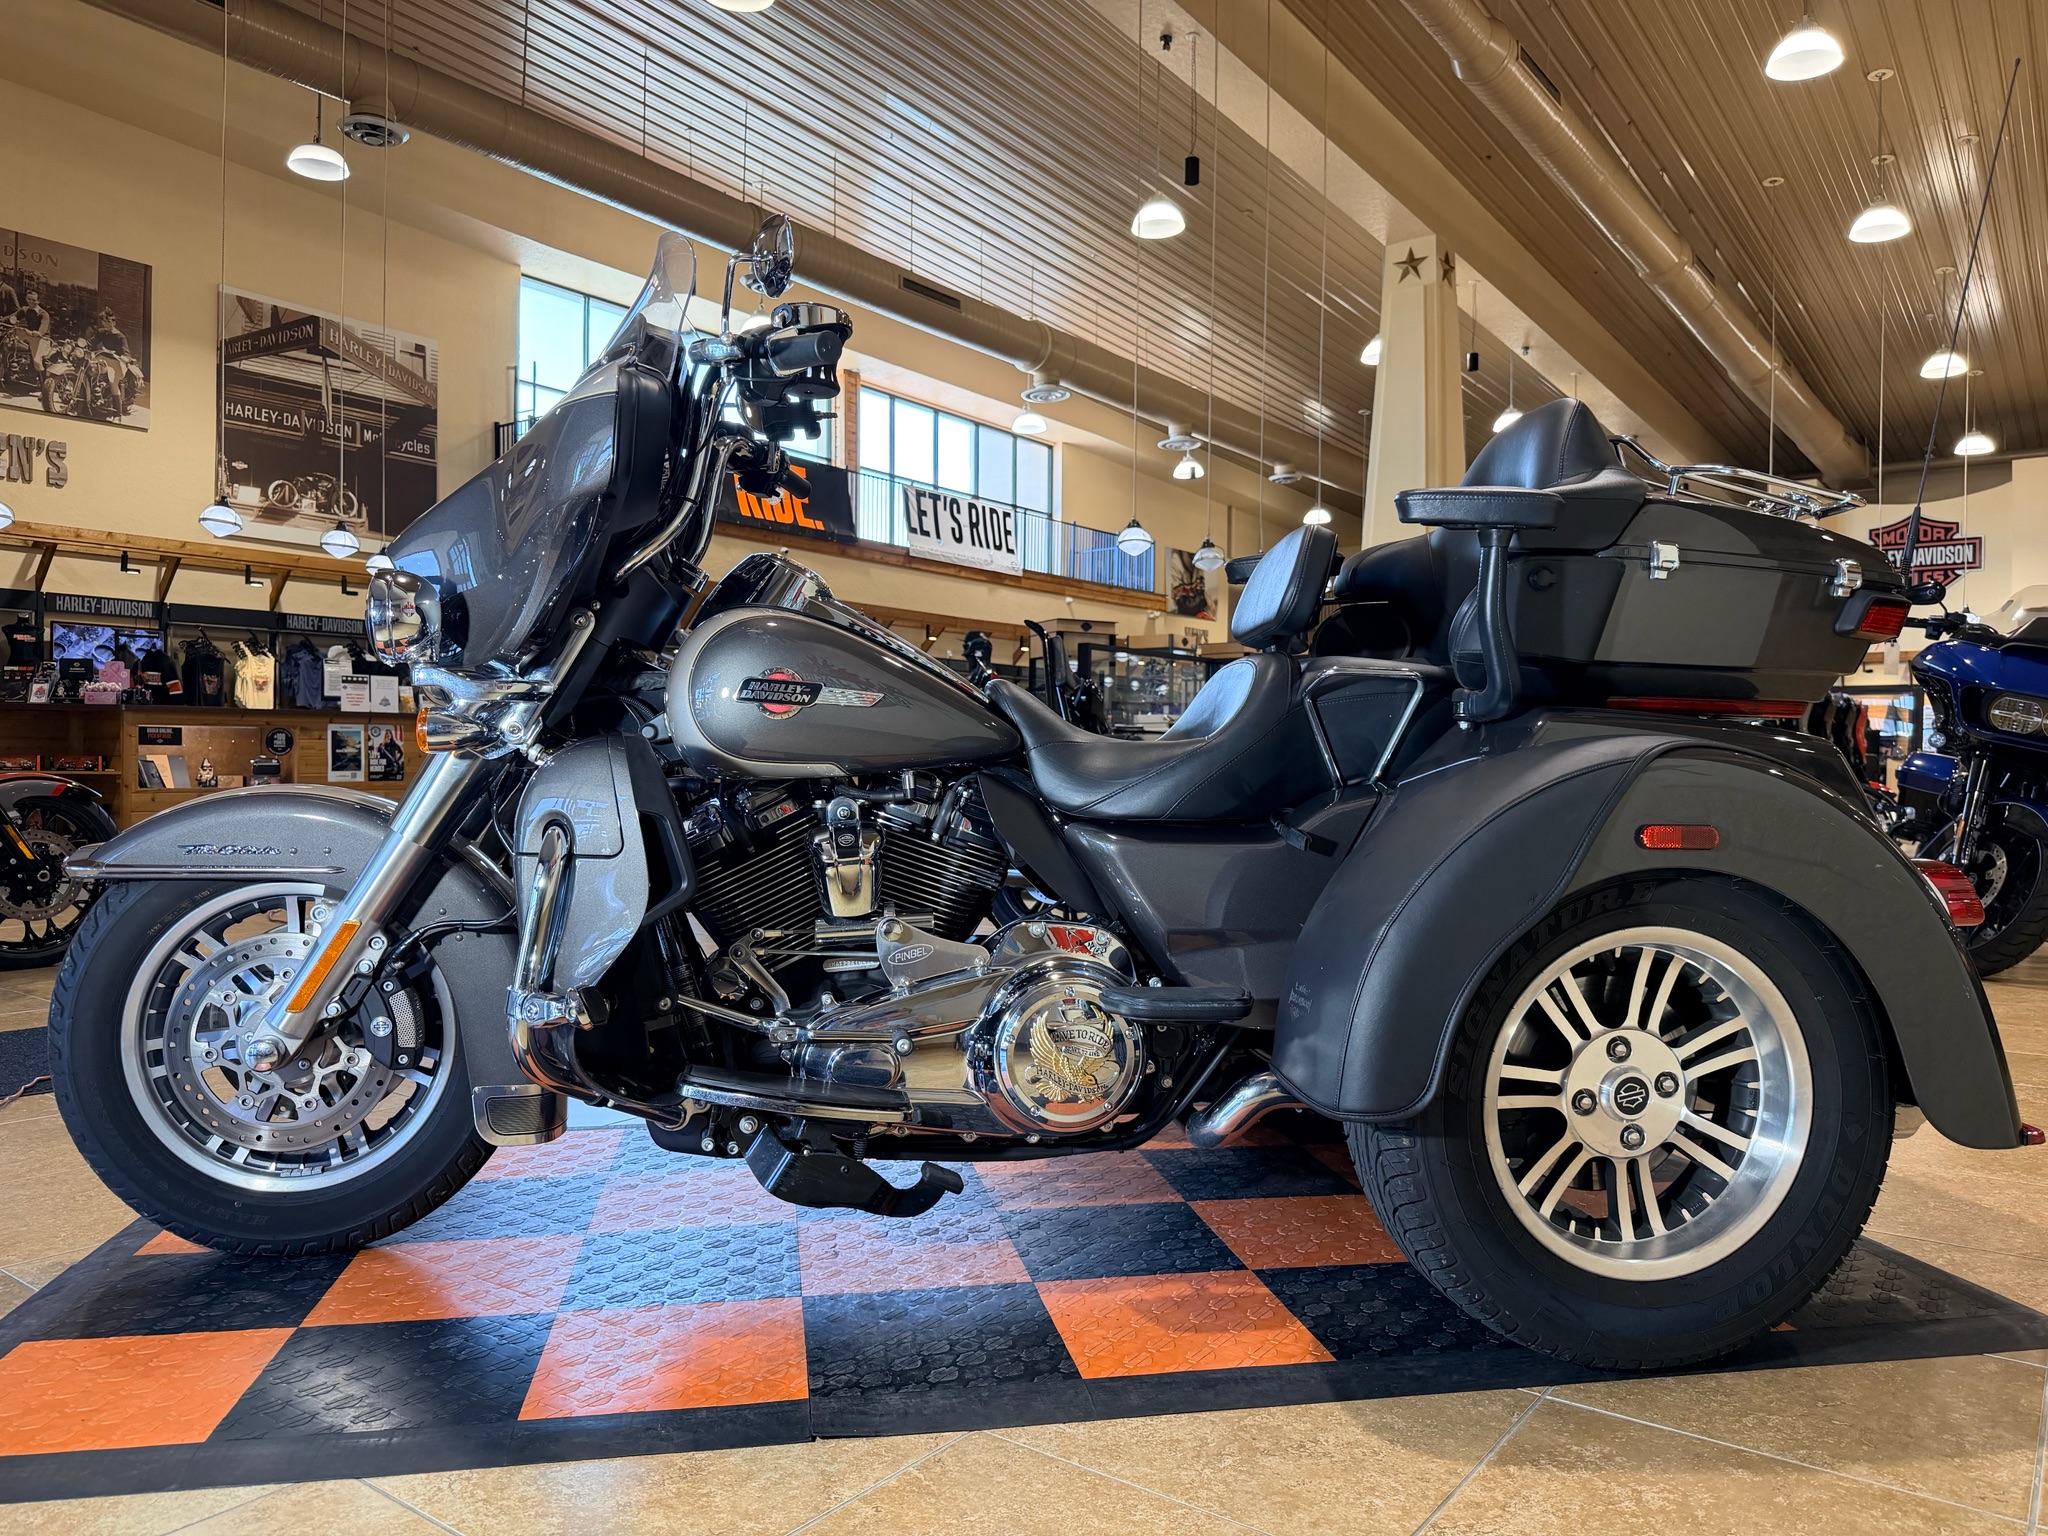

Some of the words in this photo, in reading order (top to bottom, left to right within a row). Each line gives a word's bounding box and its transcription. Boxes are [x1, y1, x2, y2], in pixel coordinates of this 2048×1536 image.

[0, 432, 68, 489] N'S
[904, 489, 963, 544] LET'S
[967, 500, 1016, 555] RIDE
[1882, 525, 1946, 545] MOOR
[56, 595, 153, 618] HARLEY-DAVIDSON
[286, 614, 363, 634] HARLEY-DAVIDSON
[740, 689, 811, 703] DAVIDSON
[747, 681, 811, 694] HARLEY-
[894, 946, 927, 963] PINGEL
[1446, 880, 1658, 1101] SIGNATURE
[1714, 1155, 1861, 1323] DUNLOP
